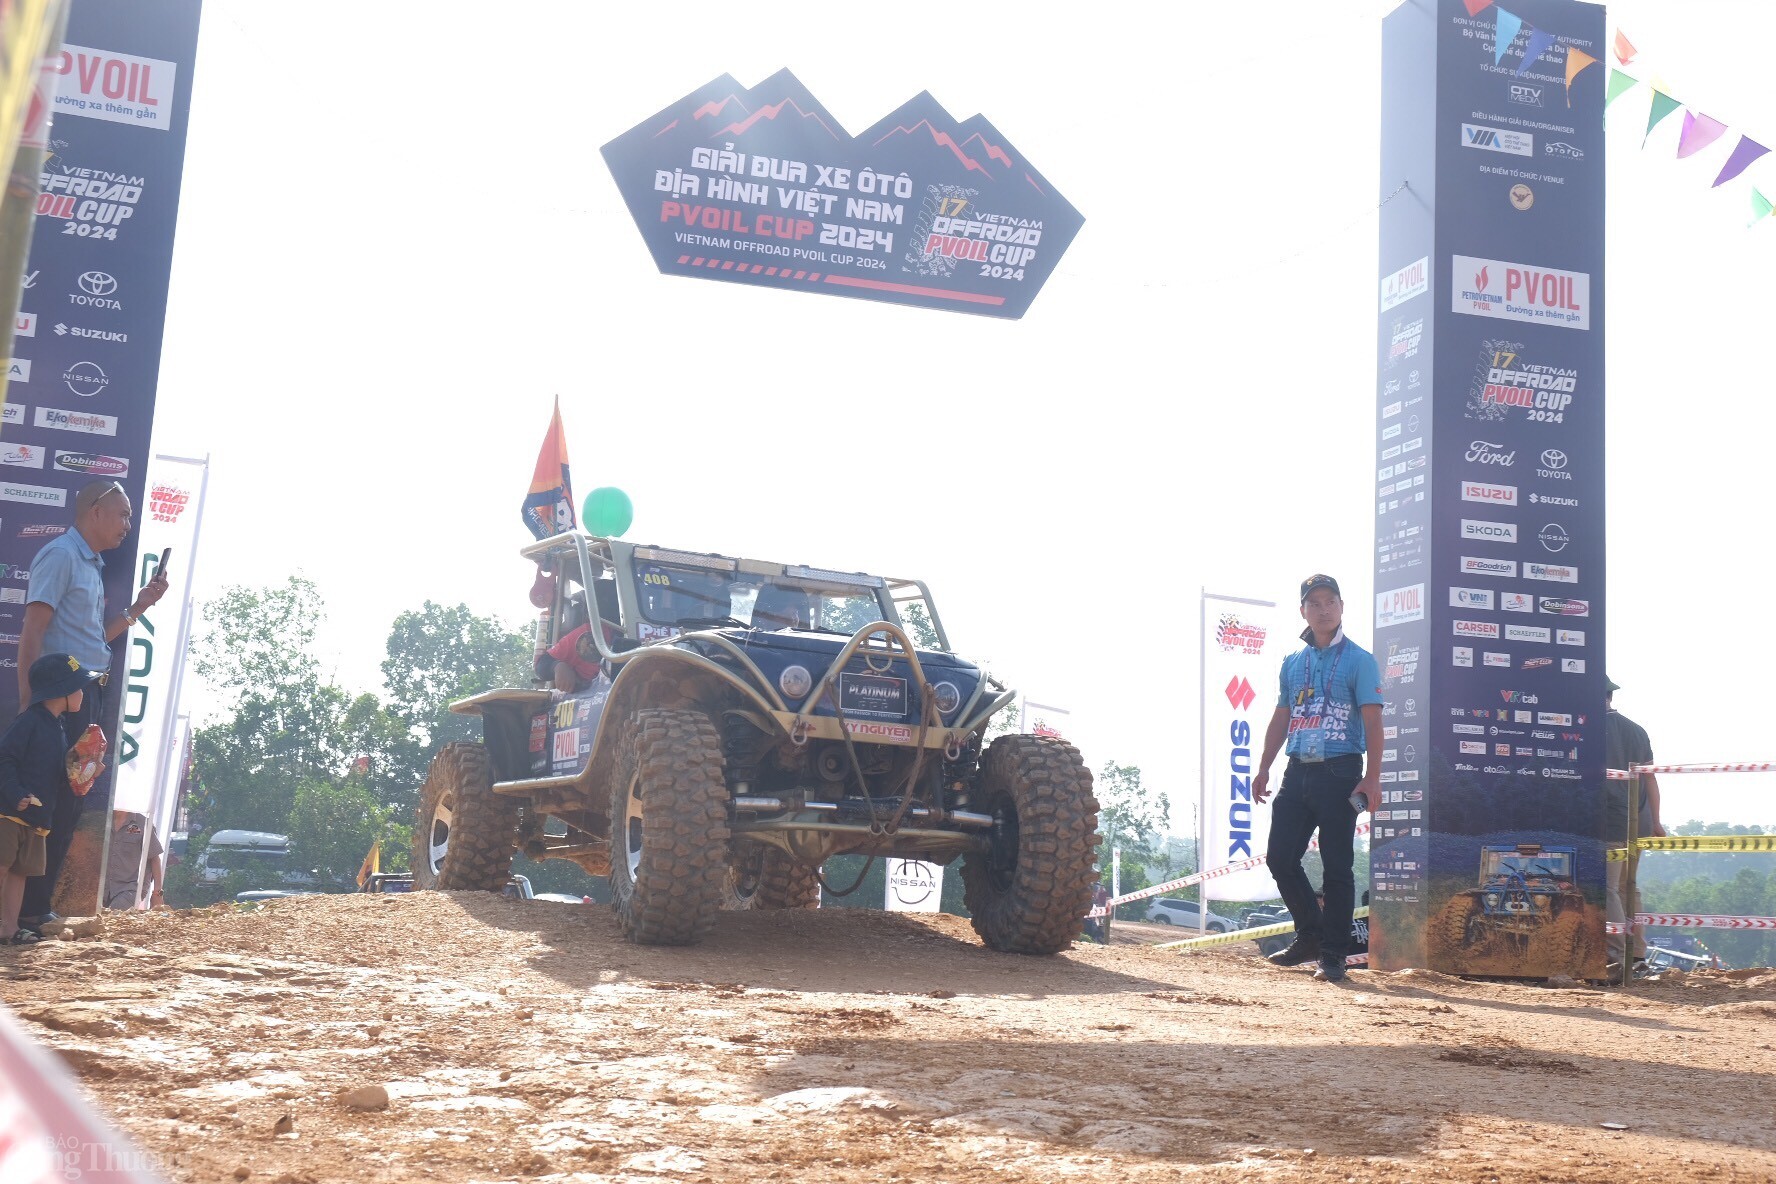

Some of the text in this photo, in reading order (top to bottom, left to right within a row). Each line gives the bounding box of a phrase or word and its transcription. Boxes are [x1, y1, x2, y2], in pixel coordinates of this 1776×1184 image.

[1463, 28, 1474, 38] Bộ
[1475, 31, 1490, 40] Văn
[1557, 36, 1592, 47] AUTHORITY
[1554, 45, 1564, 54] Du
[1546, 54, 1563, 64] thao
[55, 95, 157, 120] ường xa thêm gần
[1488, 112, 1507, 122] HÀNH
[62, 165, 144, 187] VIETNAM
[691, 142, 913, 199] GIẢI ĐUA XE ÔTÔ
[1480, 166, 1490, 174] ĐỊA
[1543, 175, 1564, 184] VENUE
[41, 173, 142, 204] FFROAD
[654, 167, 904, 225] ĐỊA HÌNH VIỆT NAM
[34, 193, 134, 226] OIL CUP
[939, 197, 968, 217] 17
[660, 200, 894, 254] PVOIL CUP 2024
[975, 212, 1043, 230] VIETNAM
[62, 221, 118, 241] 2024
[932, 216, 1042, 246] OFFROAD
[674, 232, 886, 270] VIETNAM OFFROAD PVOIL CUP 2024
[924, 232, 1036, 267] PVOIL CUP
[979, 264, 1024, 282] 2024
[1398, 262, 1424, 293] PVOIL
[1506, 268, 1580, 310] PVOIL
[69, 294, 122, 310] TOYOTA
[1462, 291, 1502, 304] PETROVIETNAM
[1473, 300, 1491, 311] PVOIL
[1506, 304, 1533, 317] Đường
[1545, 310, 1564, 319] thêm
[70, 326, 128, 342] SUZUKI
[1492, 351, 1516, 368] 17
[1522, 363, 1577, 378] VIETNAM
[63, 373, 109, 385] NISSAN
[1488, 368, 1576, 393] OFFROAD
[1482, 384, 1572, 411] PVOIL CUP
[1526, 410, 1564, 424] 2024
[1465, 440, 1516, 467] Ford
[62, 455, 122, 470] Dobinsons
[1536, 468, 1572, 480] TOYOTA
[4, 487, 60, 501] SCHAEFFLER
[1466, 486, 1512, 501] ISUZU
[1540, 496, 1578, 506] SUZUKI
[160, 503, 184, 516] CUP
[152, 514, 176, 523] 2024
[1466, 525, 1512, 538] SKODA
[1538, 534, 1570, 542] NISSAN
[1466, 560, 1512, 572] BFGoodrich
[644, 574, 670, 586] 408
[1394, 588, 1420, 613] PVOIL
[1544, 600, 1585, 610] Dobinsons
[1225, 628, 1266, 639] OFFROAD
[1456, 622, 1497, 634] CARSEN
[1509, 630, 1546, 638] SCHAEFFLER
[1222, 636, 1264, 648] PVOIL CUP
[1404, 663, 1418, 676] CUP
[848, 686, 900, 699] PLATINUM
[555, 731, 576, 759] PVOIL
[890, 878, 936, 888] NISSAN
